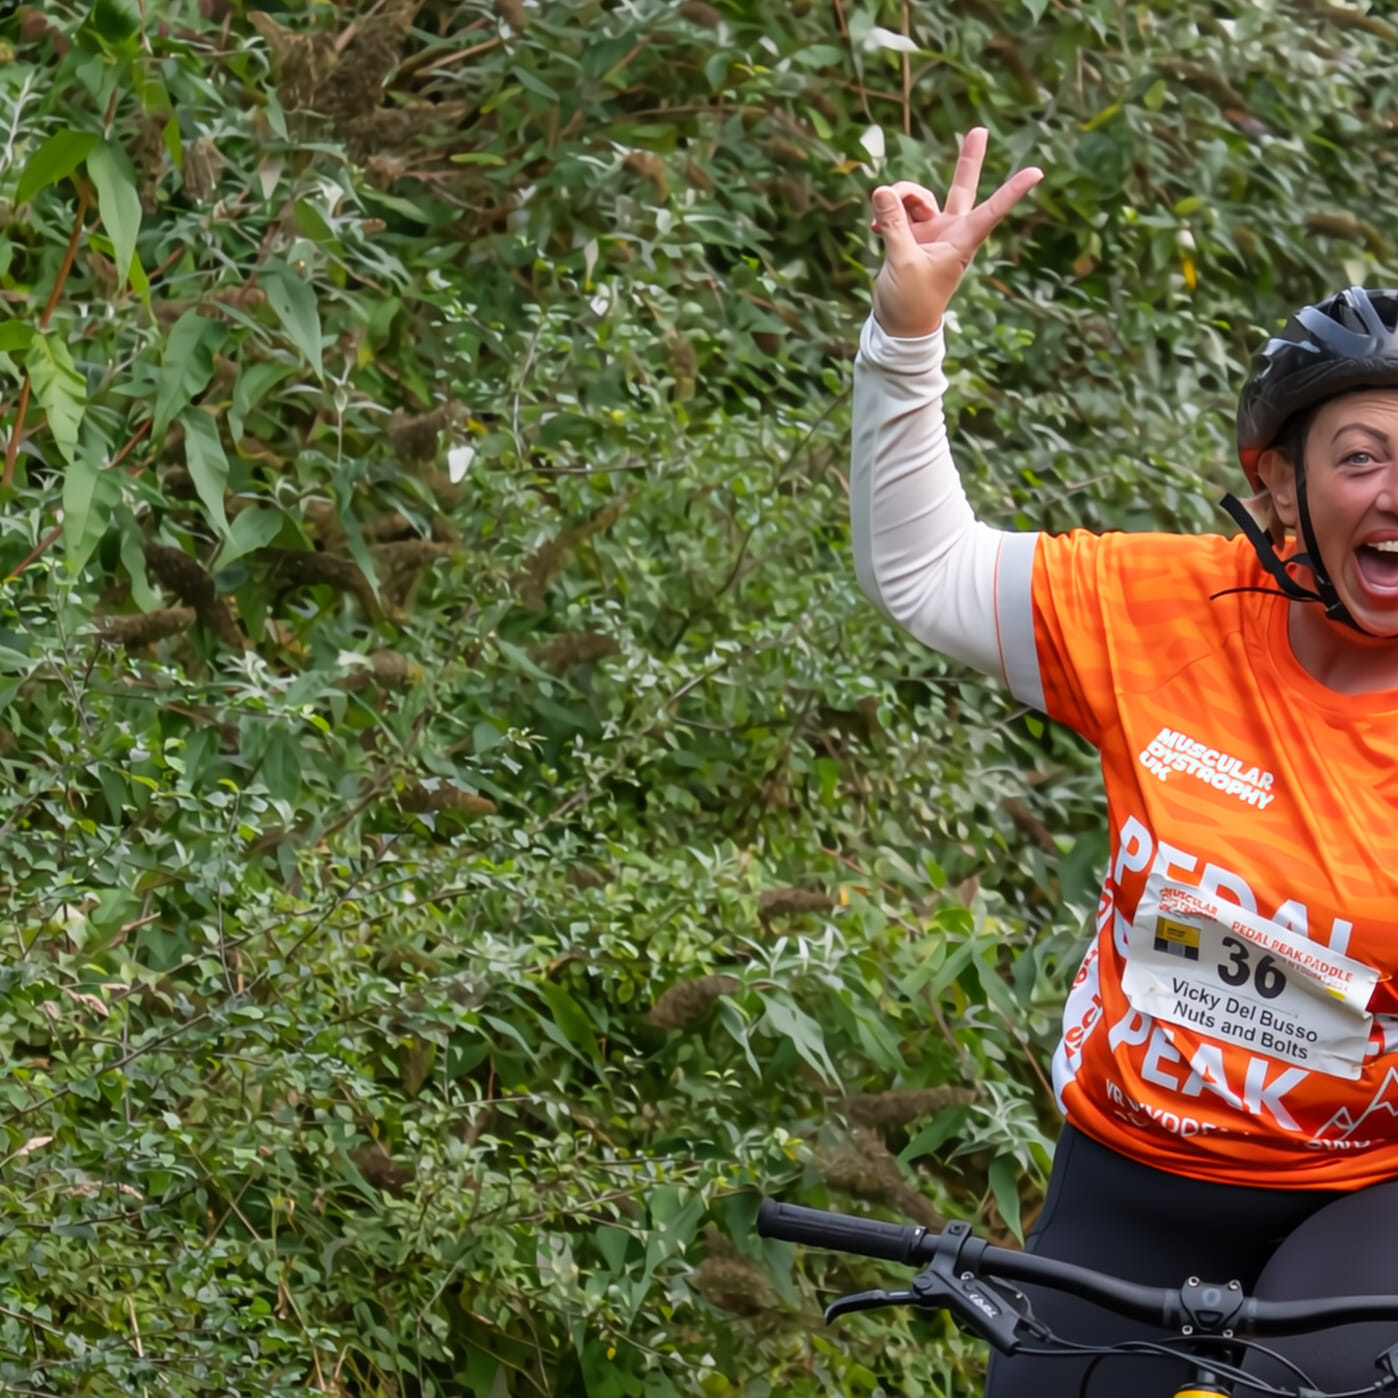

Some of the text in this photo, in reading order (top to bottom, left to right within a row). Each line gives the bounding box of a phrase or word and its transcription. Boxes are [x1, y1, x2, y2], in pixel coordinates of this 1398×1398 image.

[1139, 751, 1172, 781] UK
[1147, 740, 1275, 809] DYSTROPHY
[1156, 728, 1274, 791] MUSCULAR
[1217, 936, 1287, 999] 36
[1231, 921, 1275, 948] PEDAL
[1271, 940, 1303, 962] PEAK
[1303, 956, 1353, 983] PADDLE
[1172, 977, 1318, 1043] Vicky Del Busso
[1173, 1001, 1308, 1060] Nuts and Bolts
[1108, 1006, 1311, 1132] PEAK
